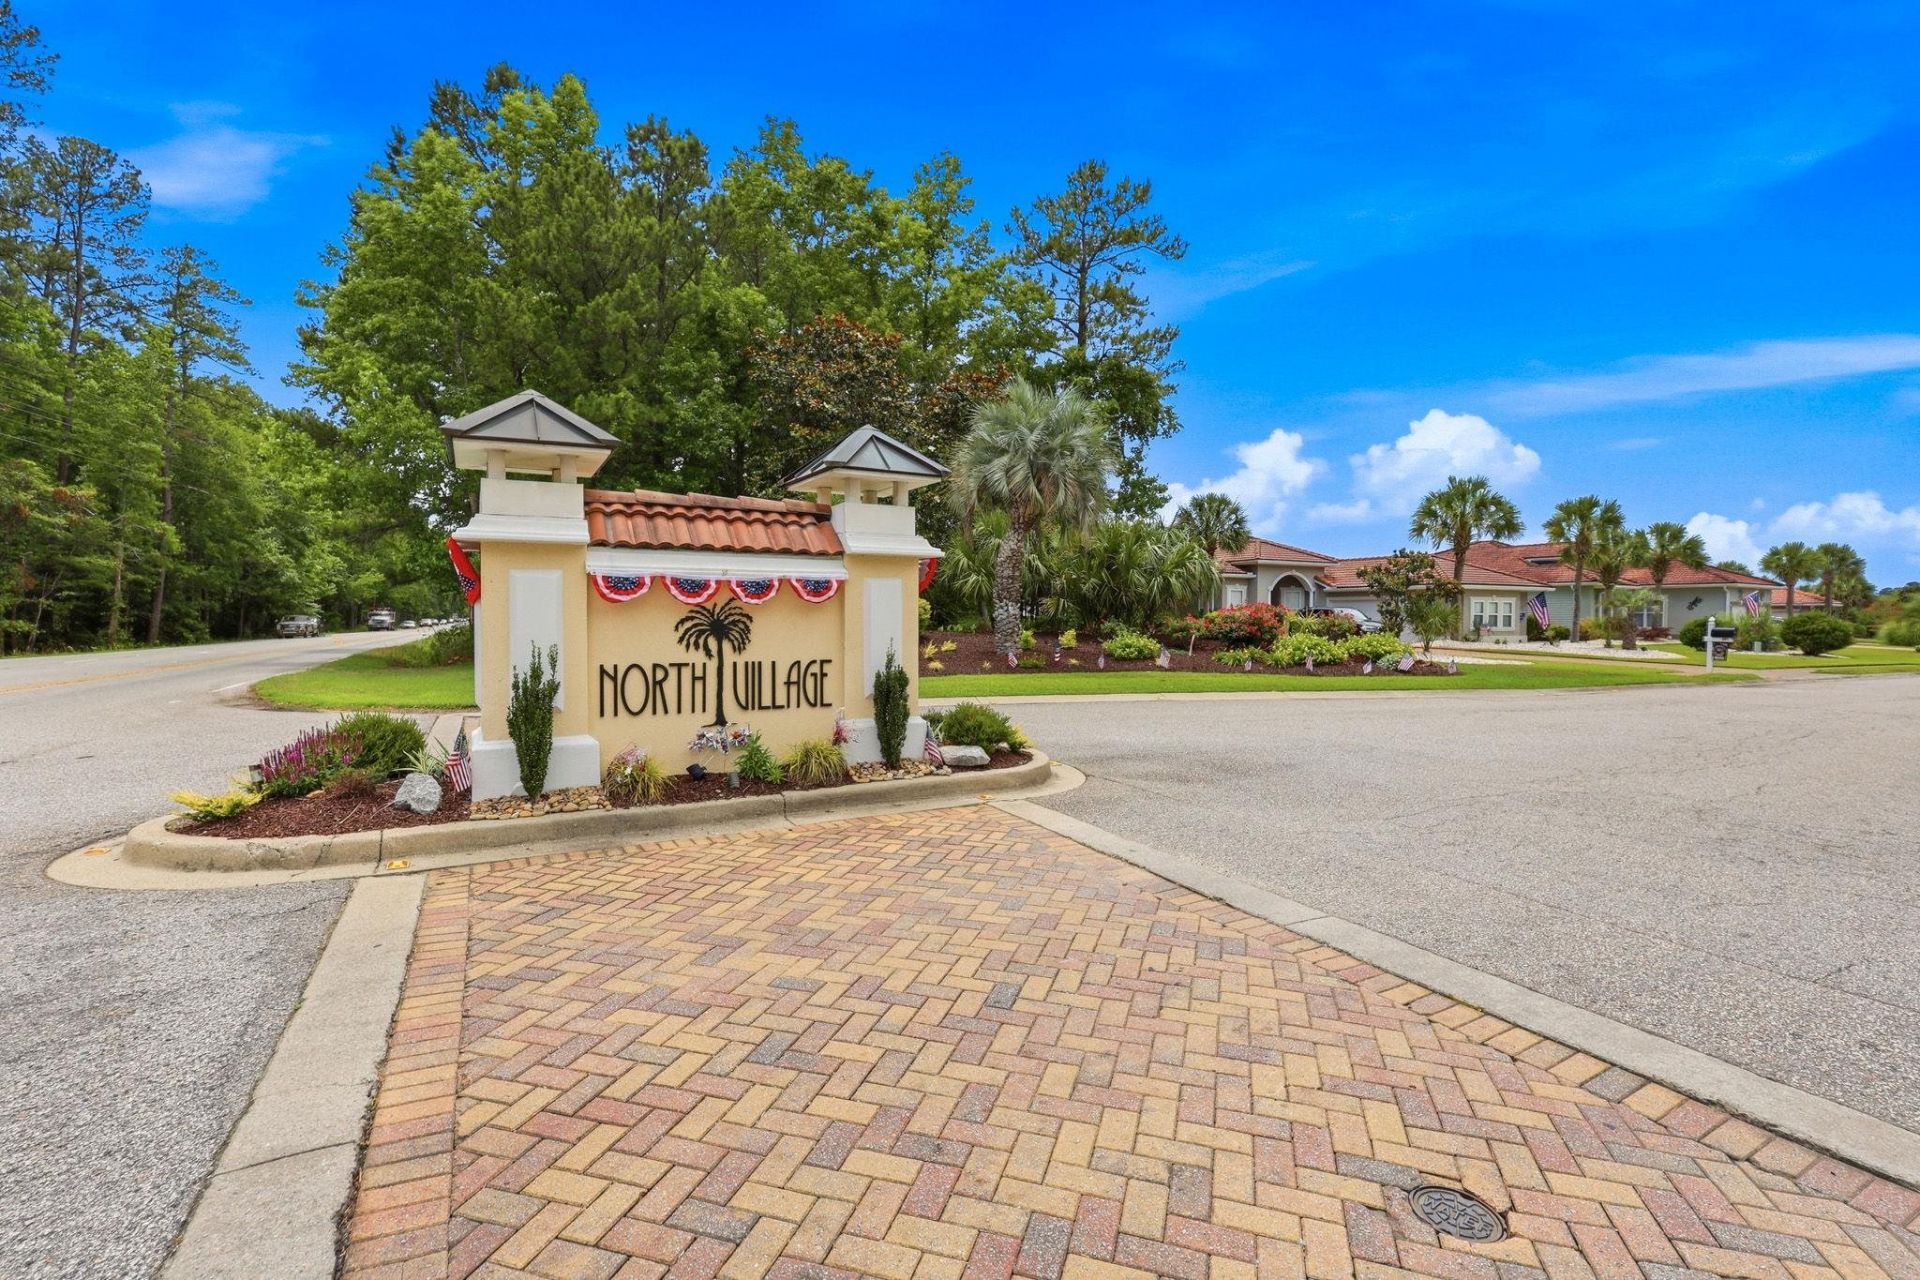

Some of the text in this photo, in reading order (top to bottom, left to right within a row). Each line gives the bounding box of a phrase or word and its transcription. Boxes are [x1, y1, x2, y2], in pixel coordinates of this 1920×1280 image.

[599, 659, 833, 717] NORTH VILLAGE
[1423, 1194, 1495, 1235] WATER
